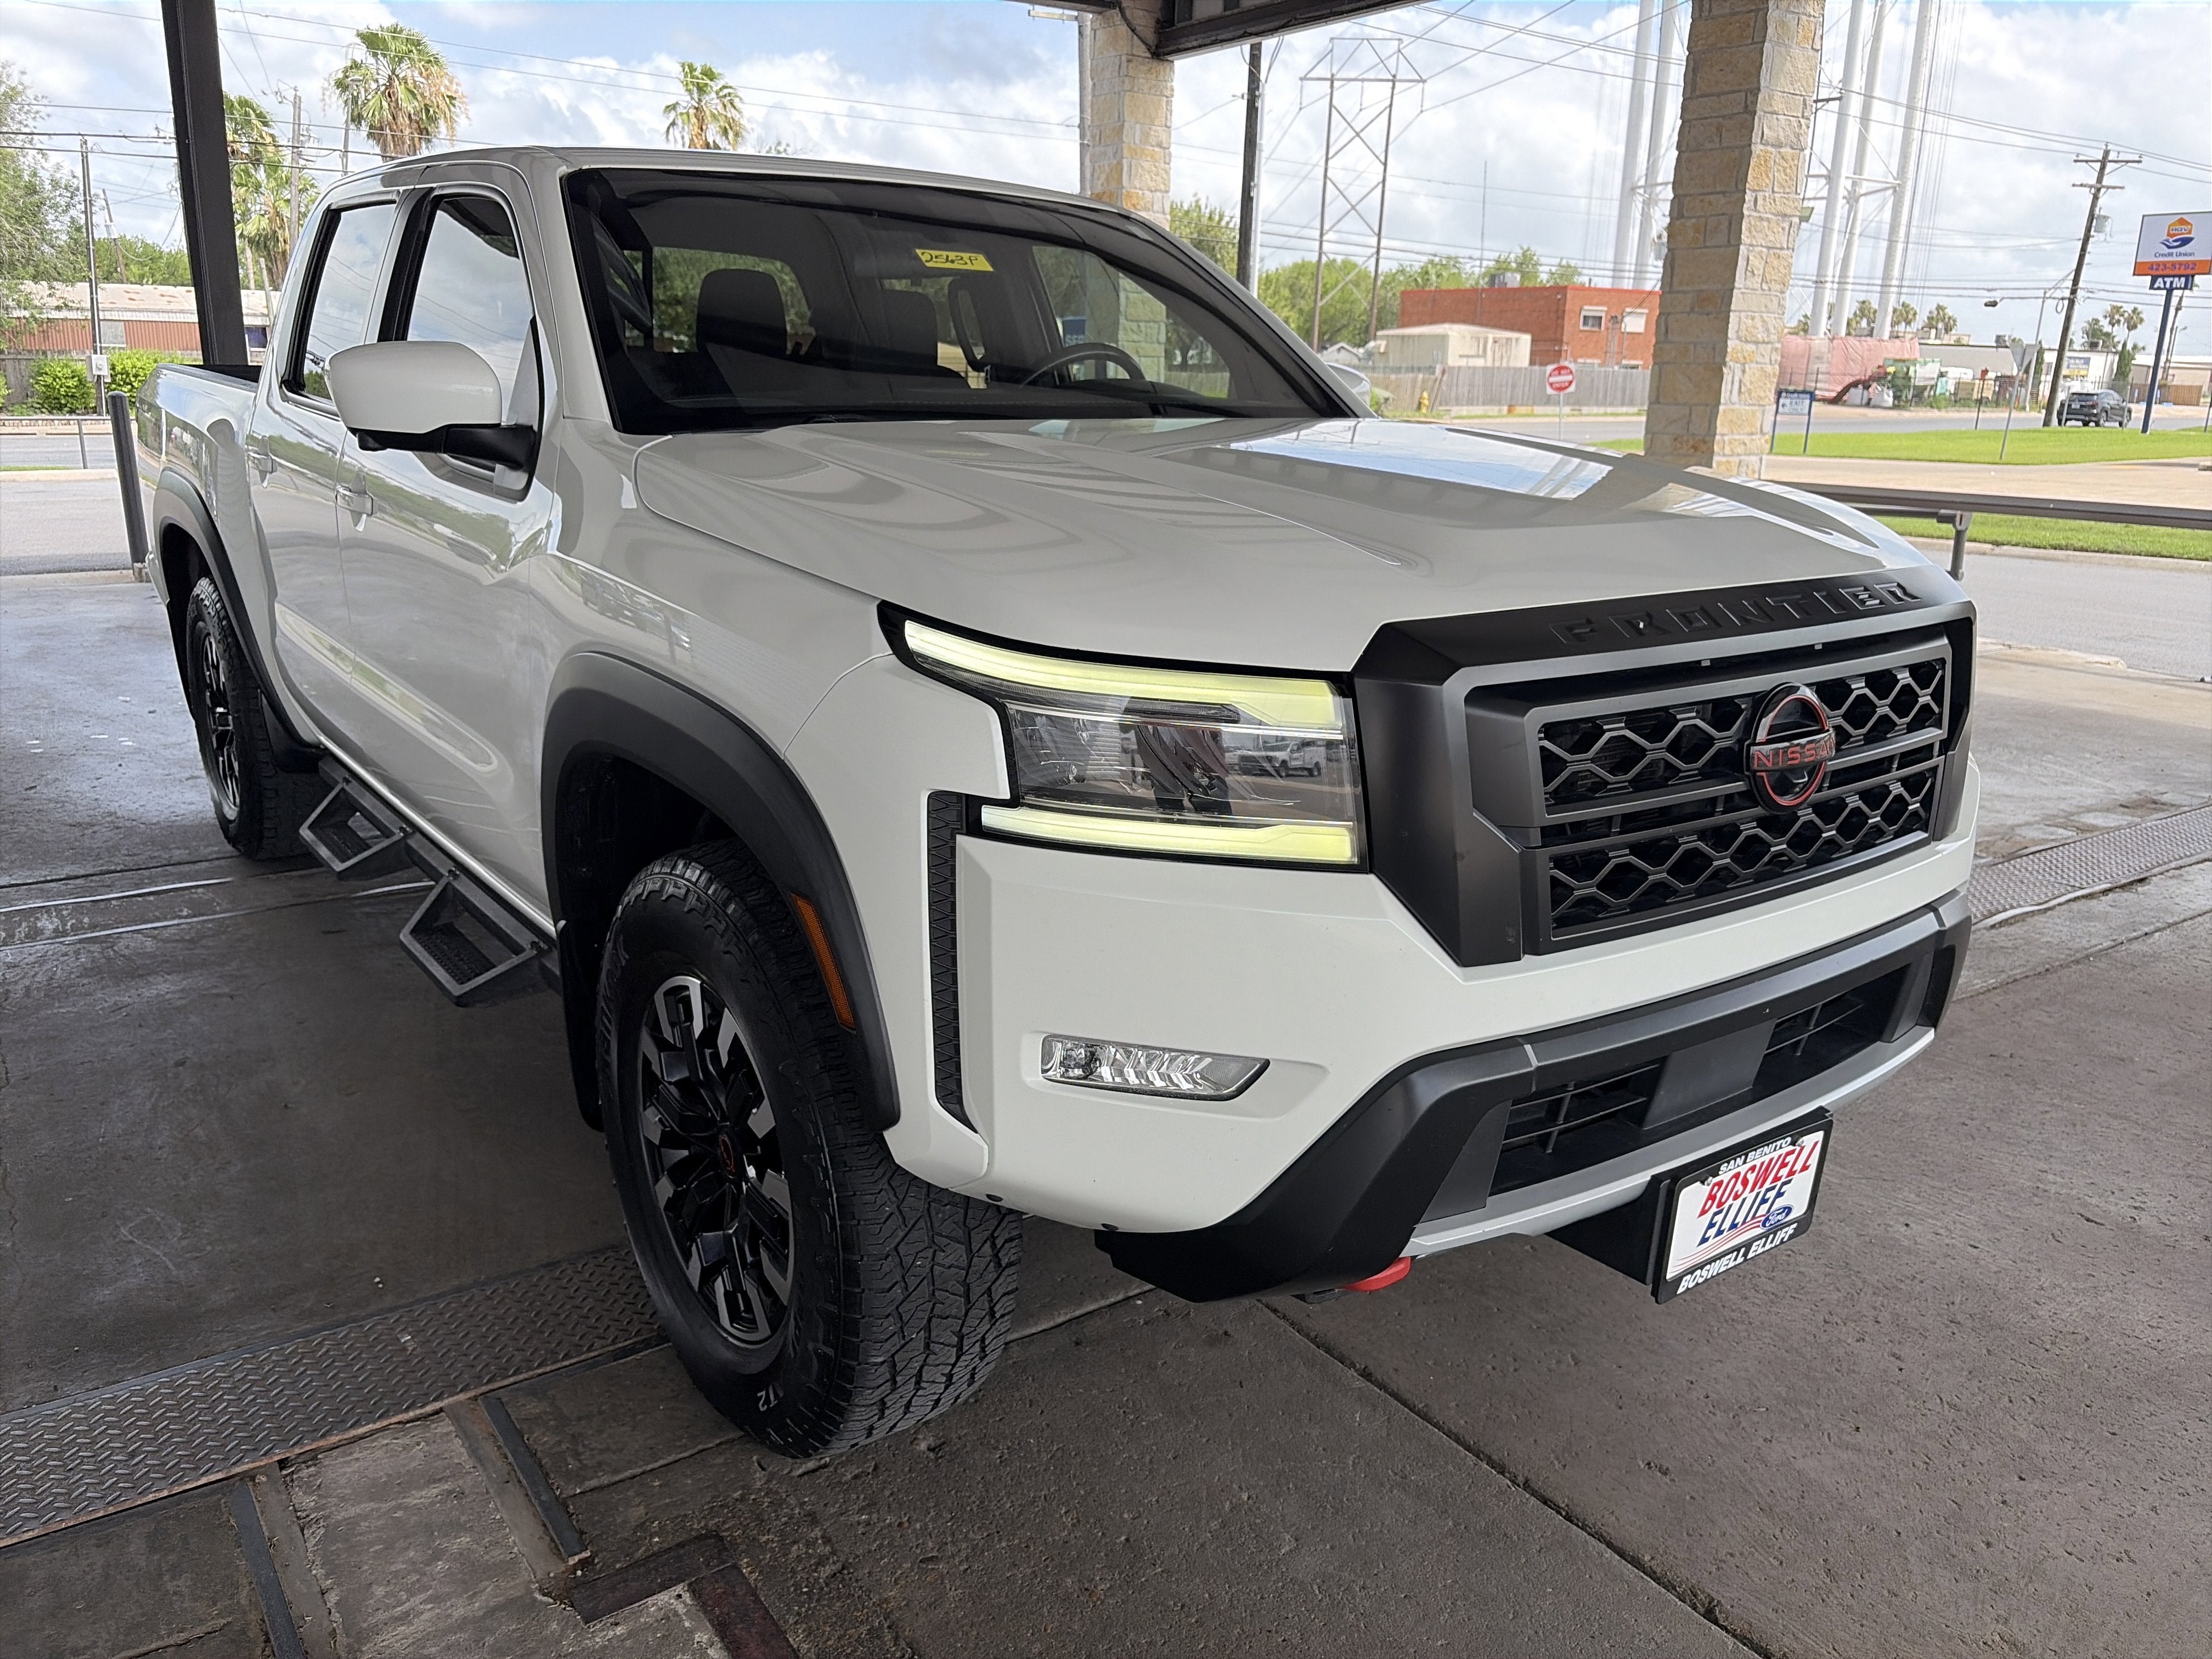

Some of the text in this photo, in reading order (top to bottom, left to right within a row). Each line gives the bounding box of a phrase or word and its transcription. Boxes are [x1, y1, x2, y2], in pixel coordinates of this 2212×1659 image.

[2153, 276, 2186, 289] ATM
[1548, 582, 1922, 645] FRONTIER
[1753, 737, 1836, 769] NISSAN
[1696, 1140, 1820, 1219] BOSWELL
[1718, 1136, 1792, 1175] SAN BENITO
[1696, 1178, 1795, 1248] ELLIFF
[1765, 1207, 1788, 1227] Ford
[1676, 1222, 1798, 1295] BOSWELL ELLIFF
